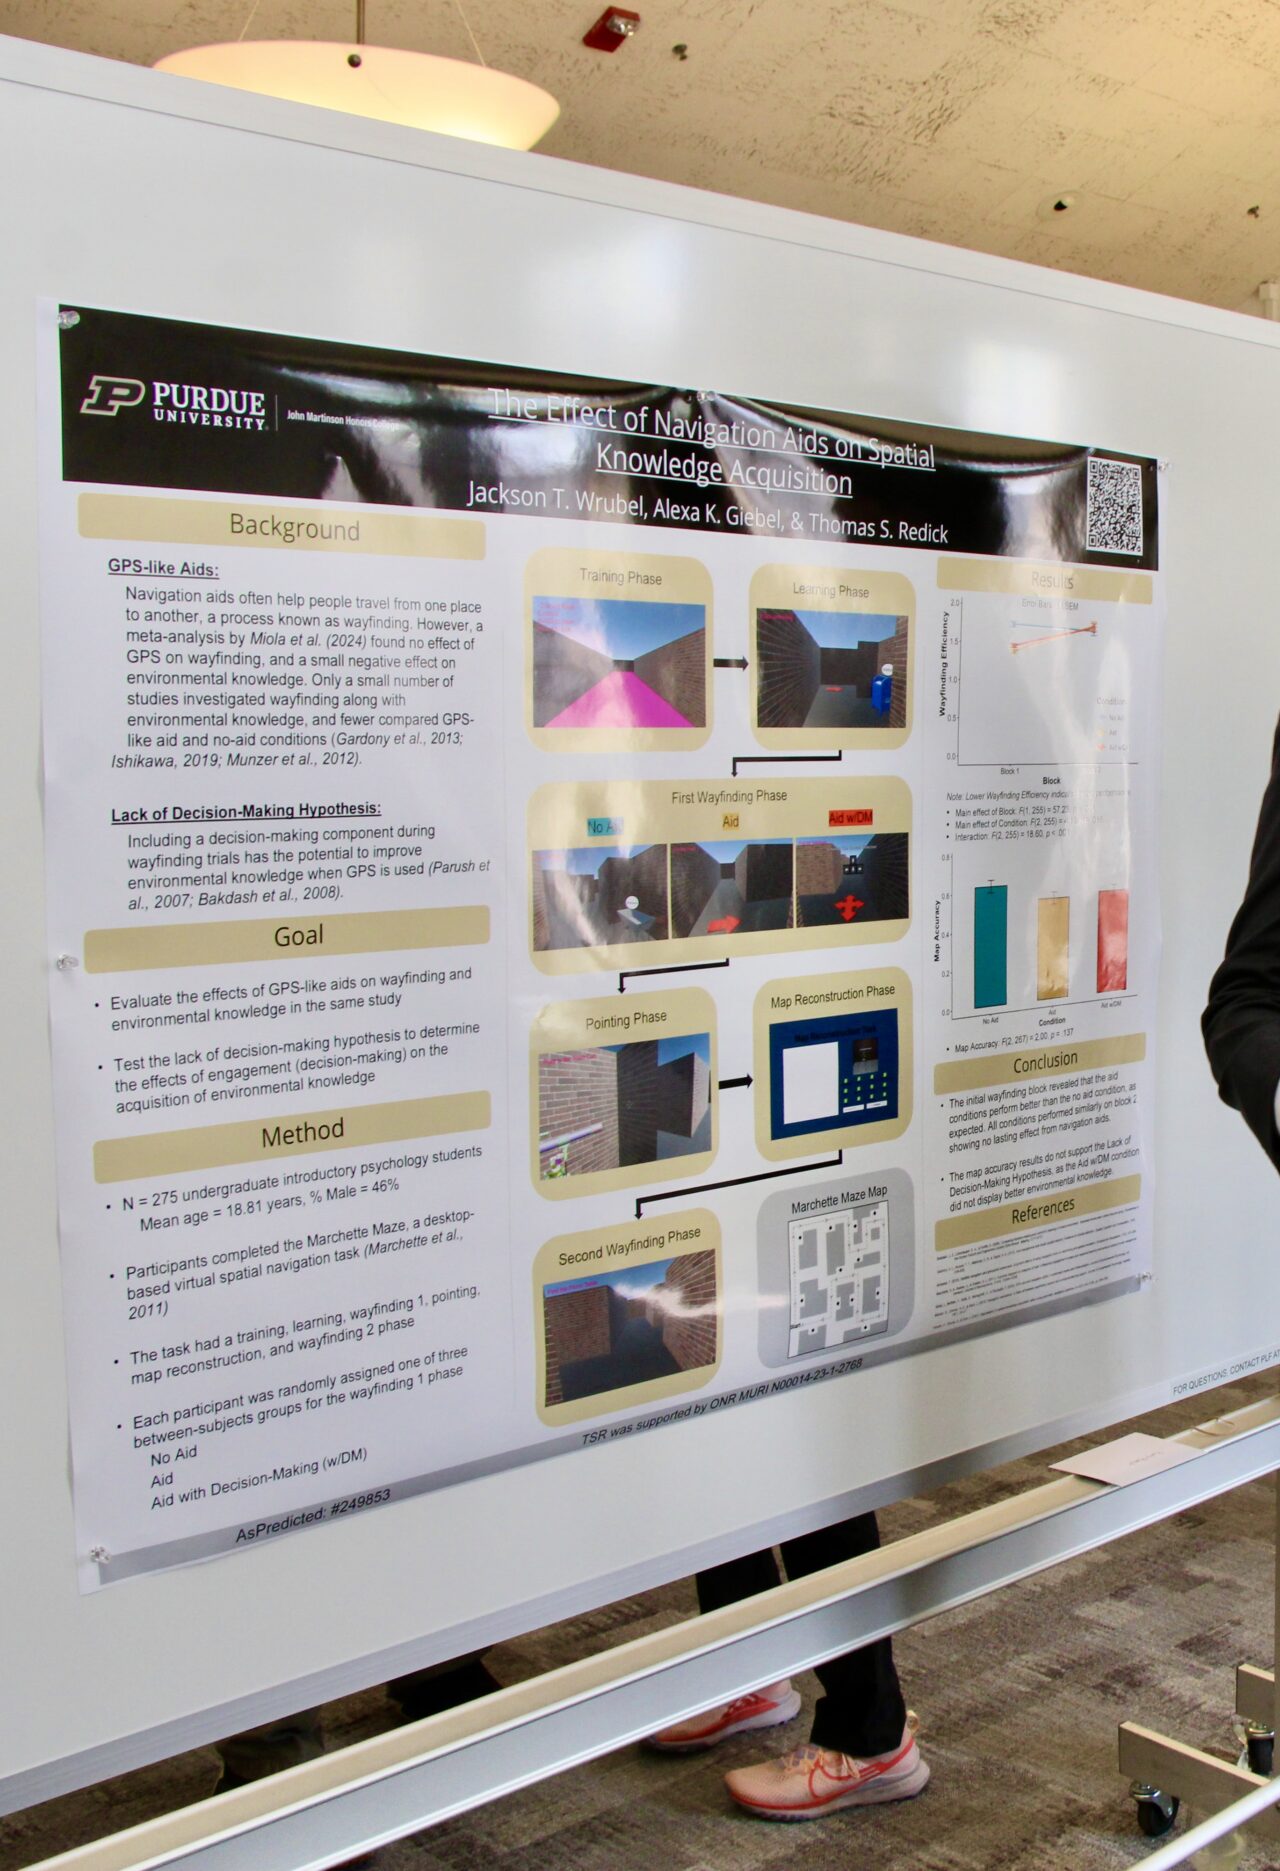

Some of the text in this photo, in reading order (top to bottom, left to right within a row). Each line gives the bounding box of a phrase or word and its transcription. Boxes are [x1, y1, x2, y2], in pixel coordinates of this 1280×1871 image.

[153, 382, 265, 416] PURDUE
[154, 408, 264, 430] UNIVERSITY
[287, 410, 305, 421] John
[306, 411, 344, 425] Martinson
[488, 388, 935, 468] The Effect of Navigation Aids on Spatial
[596, 443, 852, 495] Knowledge Acquisition
[466, 480, 947, 543] Jackson T. Wrubel, Alexa K. Giebel, & Thomas S. Redick
[231, 513, 359, 542] Background
[108, 558, 219, 577] GPS-like Aids:
[581, 567, 662, 585] Training Phase
[793, 582, 870, 599] Learning Phase
[1031, 571, 1075, 590] Results
[126, 586, 481, 614] Navigation aids often help people travel from one place
[939, 611, 950, 716] Wayfinding Efficiency
[671, 789, 787, 805] First Wayfinding Phase
[112, 801, 381, 822] Lack of Decision-Making Hypothesis:
[722, 815, 740, 828] Aid
[829, 812, 845, 824] Aid
[128, 825, 435, 849] Including a decision-making component during
[274, 923, 322, 946] Goal
[111, 967, 471, 1010] Evaluate the effects of GPS-like aids on wayfinding and
[771, 985, 895, 1008] Map Reconstruction Phase
[586, 1011, 666, 1029] Pointing Phase
[1013, 1052, 1077, 1073] Conclusion
[949, 1071, 1118, 1108] The initial wayfinding block revealed that the aid
[262, 1118, 343, 1146] Method
[791, 1185, 888, 1214] Marchette Maze Map
[1012, 1198, 1075, 1223] References
[559, 1228, 700, 1265] Second Wayfinding Phase
[129, 1286, 479, 1364] The task had a training, learning, wayfinding 1, pointing,
[1173, 1384, 1188, 1396] FOR
[1230, 1357, 1261, 1375] CONTACT
[1273, 1349, 1280, 1358] AT
[581, 1430, 608, 1446] TSR
[610, 1425, 633, 1437] was
[637, 1407, 691, 1431] supported
[694, 1404, 708, 1416] by
[710, 1393, 736, 1410] ONR
[740, 1385, 769, 1401] MURI
[150, 1444, 197, 1466] No Aid
[150, 1472, 173, 1488] Aid
[151, 1448, 366, 1509] Aid with Decision-Making (w/DM)
[236, 1489, 391, 1543] AsPredicted: #249853
